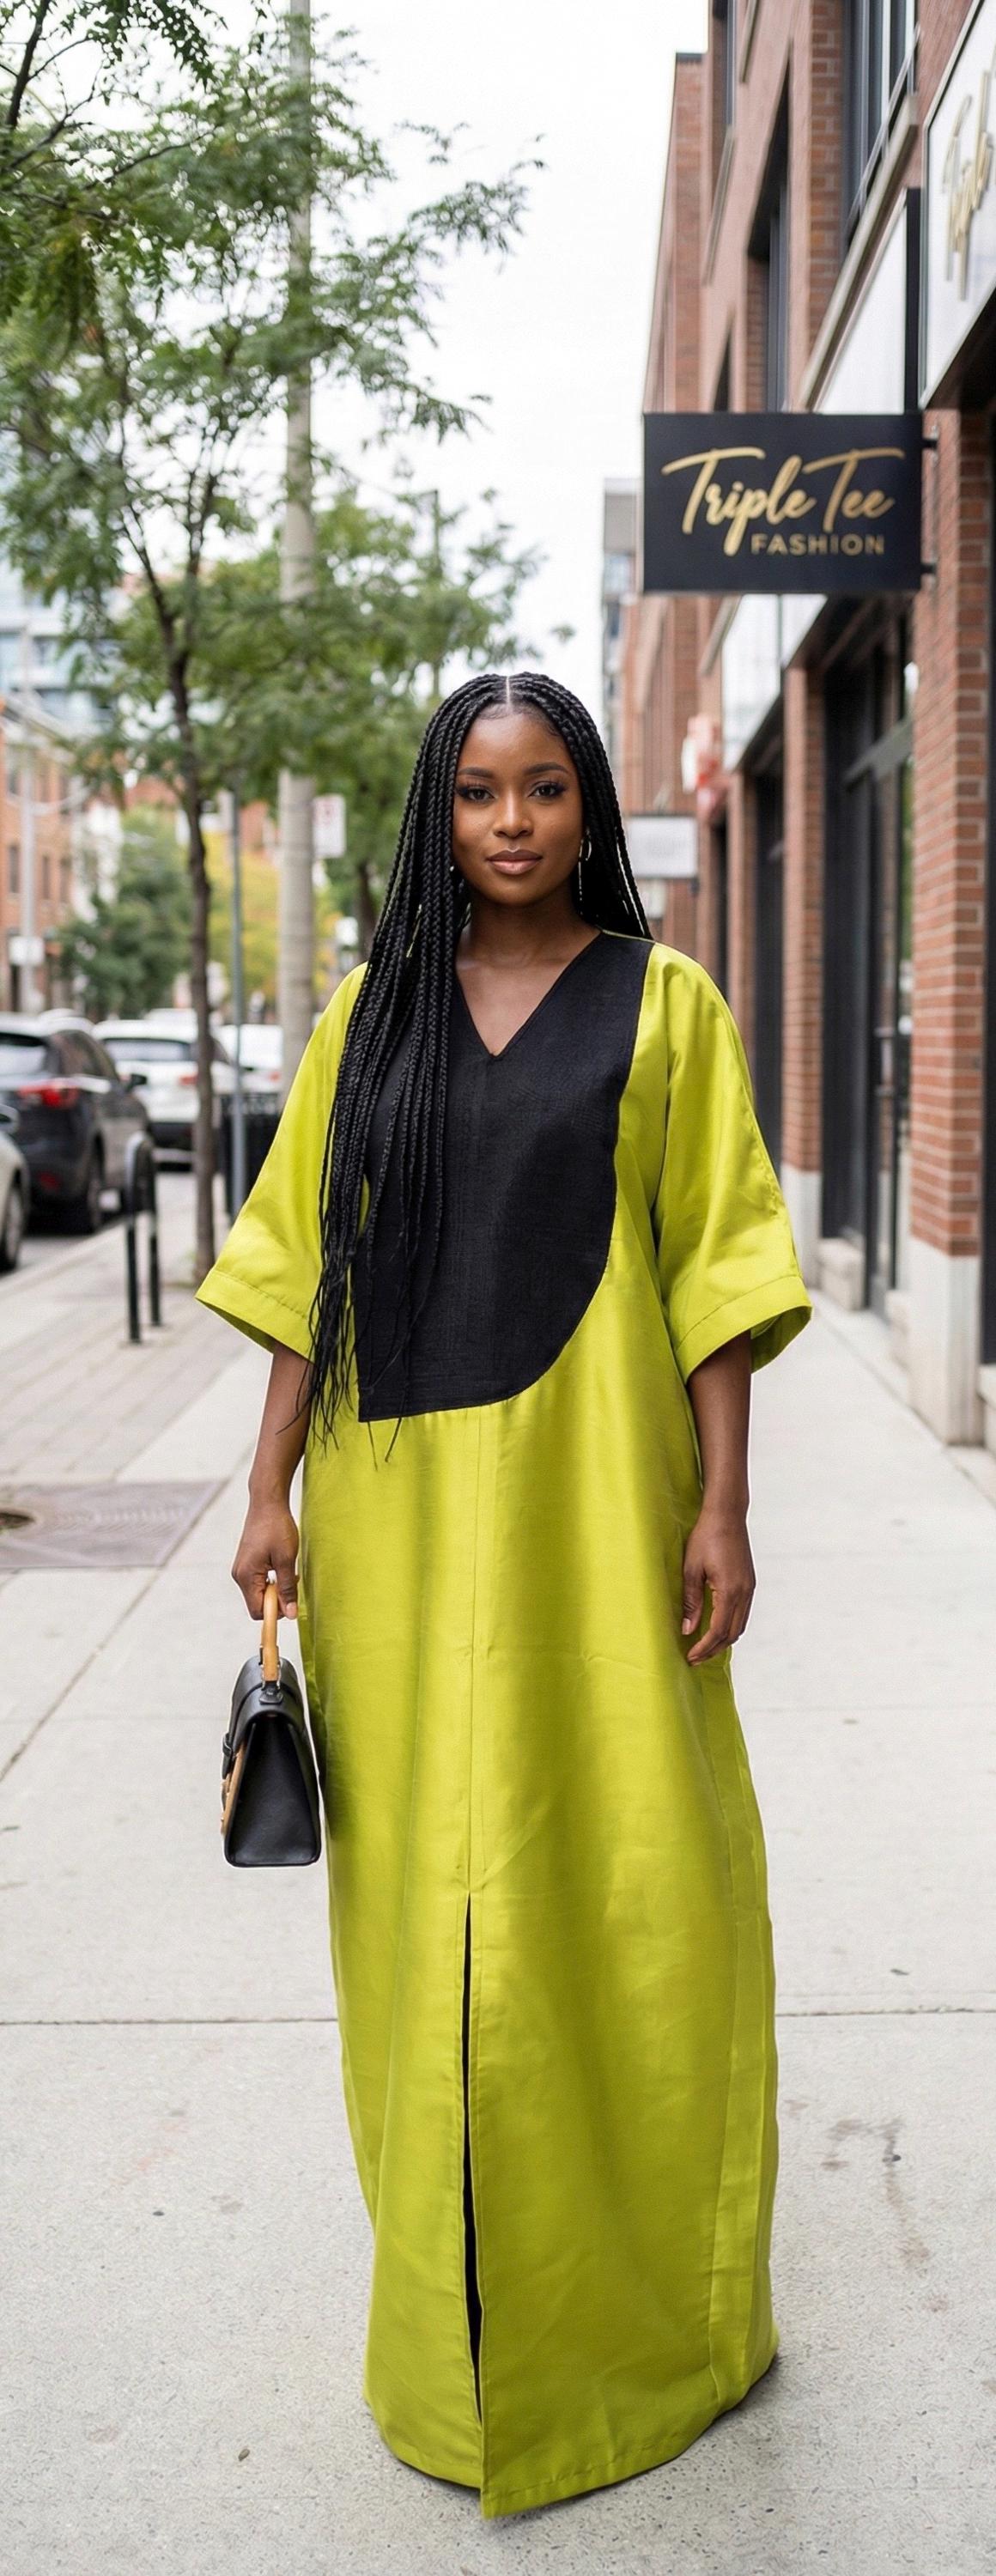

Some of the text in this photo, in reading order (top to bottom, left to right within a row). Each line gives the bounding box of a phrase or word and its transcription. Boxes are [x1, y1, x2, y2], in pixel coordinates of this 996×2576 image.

[661, 447, 905, 556] Triple Tee
[751, 534, 885, 555] FASHION
